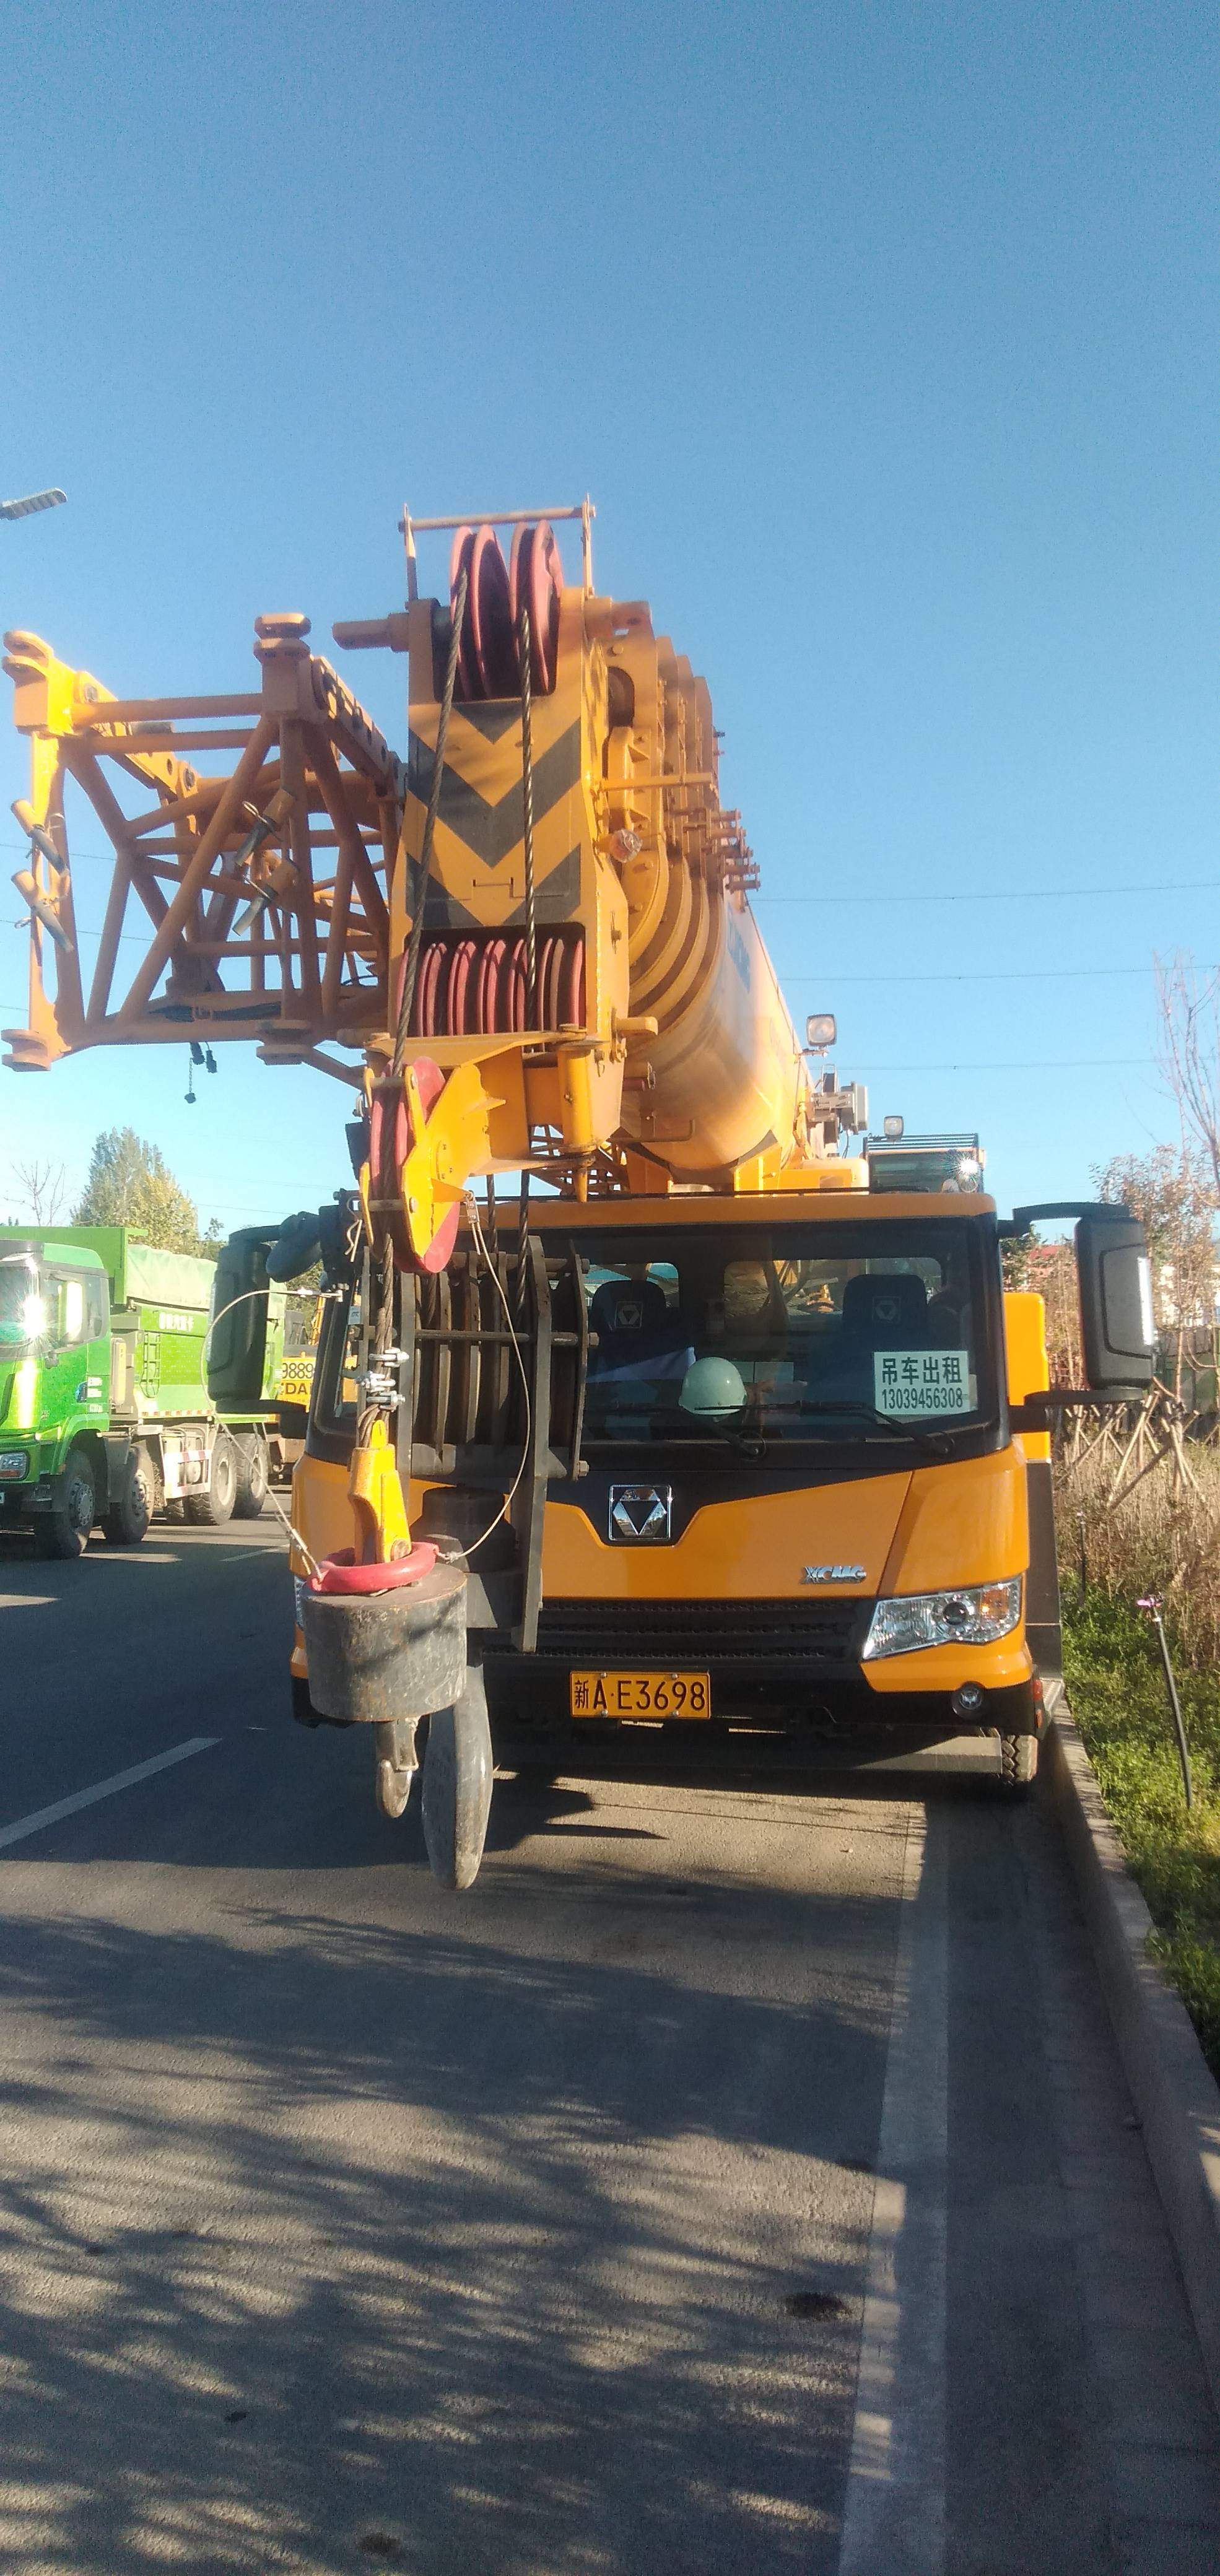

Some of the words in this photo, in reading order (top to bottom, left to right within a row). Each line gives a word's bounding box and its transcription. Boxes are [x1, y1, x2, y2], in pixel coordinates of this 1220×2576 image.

[882, 1356, 962, 1385] 吊车出租
[882, 1387, 963, 1409] 13039456308
